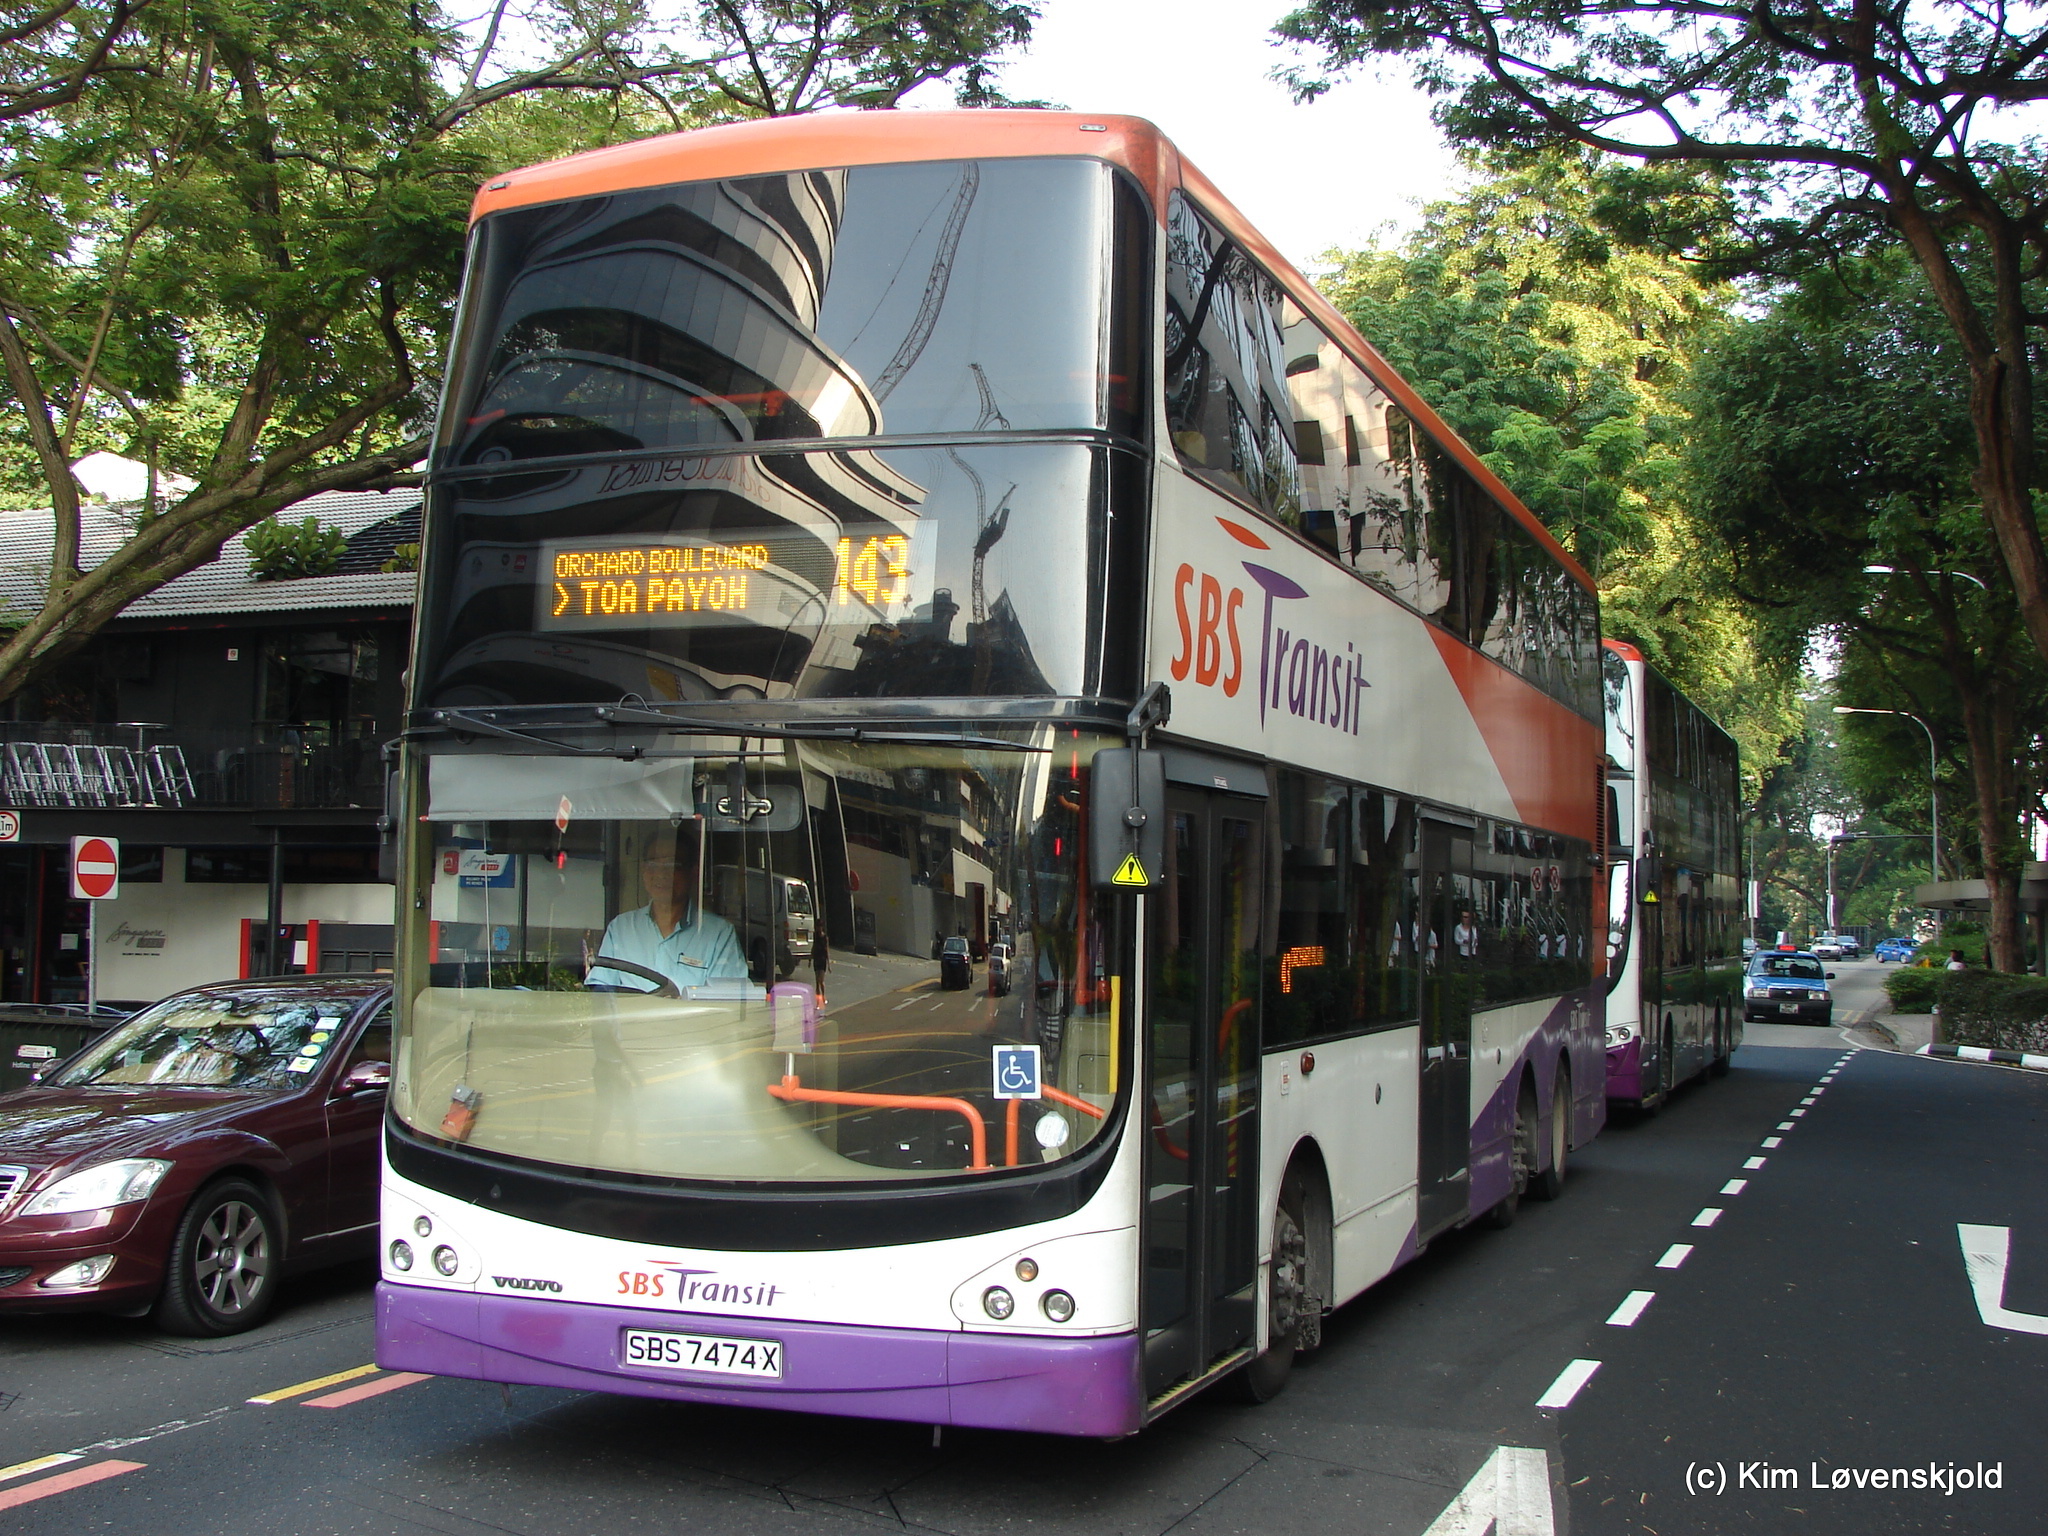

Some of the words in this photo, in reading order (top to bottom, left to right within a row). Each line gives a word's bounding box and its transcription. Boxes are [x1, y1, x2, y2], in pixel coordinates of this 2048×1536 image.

[555, 549, 645, 578] ORCHARD
[649, 545, 769, 574] BOULEVARD
[836, 534, 908, 606] 143
[580, 579, 638, 615] TOA
[647, 575, 747, 612] PAYOH
[1170, 562, 1244, 698] SBS
[1241, 560, 1372, 736] Transit
[491, 1275, 563, 1293] VOLVO
[617, 1271, 664, 1298] SBS
[663, 1267, 786, 1307] Transit
[629, 1335, 778, 1372] SBS7474X
